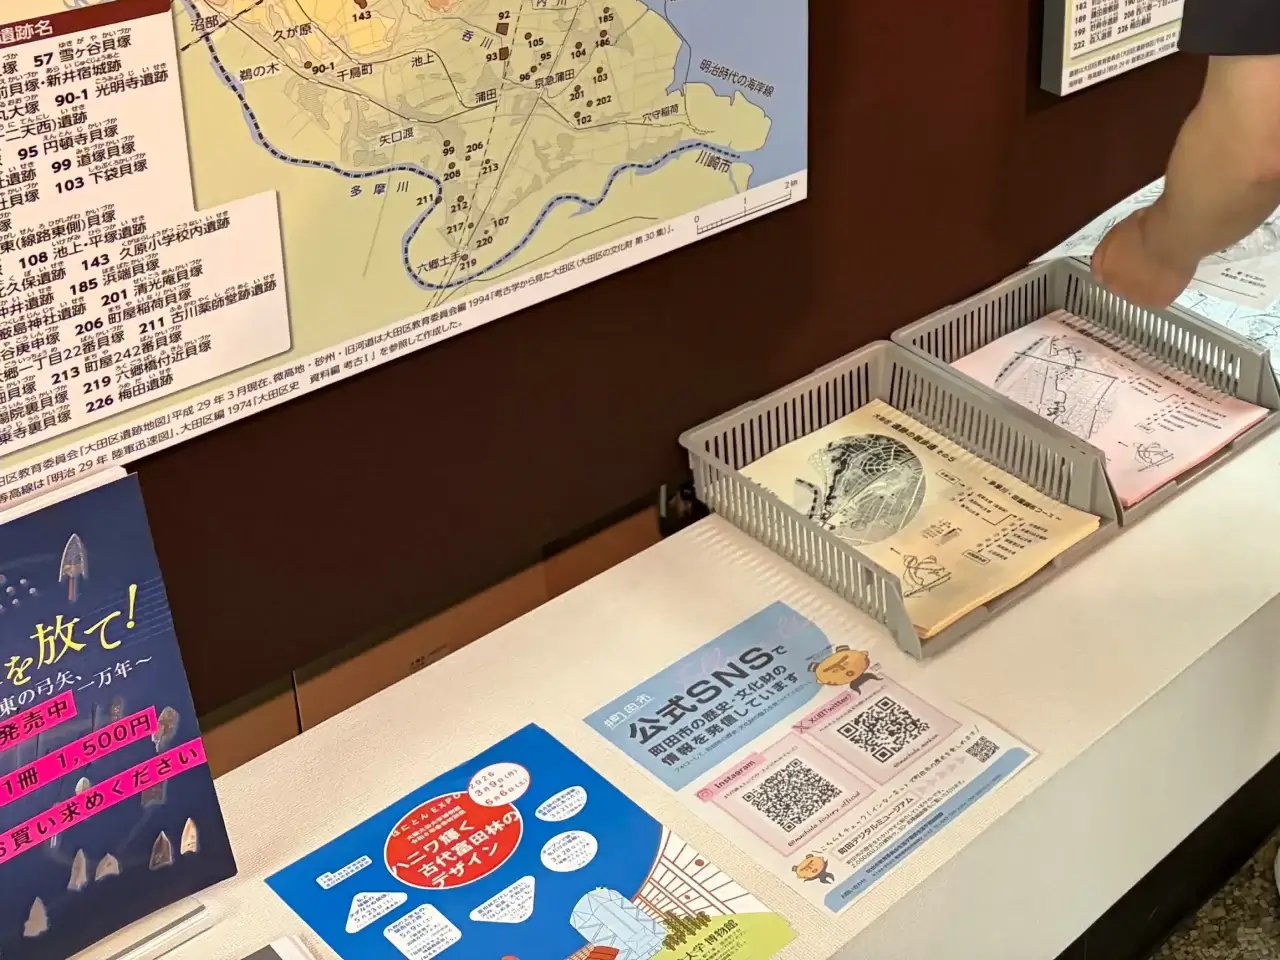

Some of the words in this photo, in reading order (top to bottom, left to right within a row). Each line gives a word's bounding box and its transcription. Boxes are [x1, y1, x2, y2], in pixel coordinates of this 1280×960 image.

[190, 15, 220, 32] 沼部
[352, 10, 372, 22] 143
[498, 10, 511, 21] 92
[598, 13, 614, 24] 185
[273, 24, 313, 42] 久が原
[34, 52, 54, 67] 57
[59, 35, 132, 63] 雪ヶ谷貝塚
[411, 53, 435, 69] 池上
[312, 62, 335, 74] 90-1
[337, 64, 373, 81] 千鳥町
[534, 69, 575, 89] 京急蒲田
[592, 73, 608, 84] 103
[699, 58, 775, 99] 明治時代の海岸線
[55, 88, 89, 107] 90-1
[96, 69, 169, 98] 光明寺遺跡
[475, 88, 498, 104] 蒲田
[596, 95, 612, 107] 202
[643, 103, 680, 123] 穴守稲荷
[18, 145, 38, 160] 95
[43, 124, 119, 156] 円頓寺貝塚
[379, 128, 415, 147] 矢口渡
[466, 141, 484, 153] 206
[51, 158, 72, 173] 99
[77, 141, 136, 168] 道塚貝塚
[696, 150, 733, 174] 川崎市
[55, 177, 85, 194] 103
[90, 160, 148, 185] 下袋貝塚
[350, 181, 409, 197] 多摩川
[416, 195, 434, 205] 211
[19, 251, 48, 269] 108
[53, 221, 147, 261] 池上・平塚遺跡
[81, 253, 110, 271] 143
[120, 216, 230, 260] 久原小学校内遺跡
[69, 277, 98, 295] 185
[103, 257, 160, 286] 浜端貝塚
[416, 252, 462, 274] 六郷土手
[101, 289, 128, 307] 201
[134, 264, 203, 297] 清光庵貝塚
[75, 318, 104, 336] 206
[108, 290, 192, 325] 町屋稲荷貝塚
[469, 294, 490, 308] 1994
[139, 317, 165, 334] 211
[52, 366, 80, 384] 213
[85, 331, 182, 374] 町屋242番貝塚
[83, 376, 111, 394] 219
[116, 340, 211, 383] 六郷橋付近貝塚
[86, 395, 114, 413] 226
[118, 373, 174, 402] 梅田遺跡
[629, 644, 788, 745] 公式SNSで
[648, 665, 788, 758] 町田市の歴史・文化財の
[661, 672, 799, 767] 情報を発信しています
[3, 769, 39, 797] 1冊
[56, 717, 151, 770] 1,500円
[714, 760, 756, 789] Instagram
[391, 820, 476, 877] ハニワ輝く
[418, 810, 520, 878] 古代富田林の
[431, 842, 499, 889] デザイン
